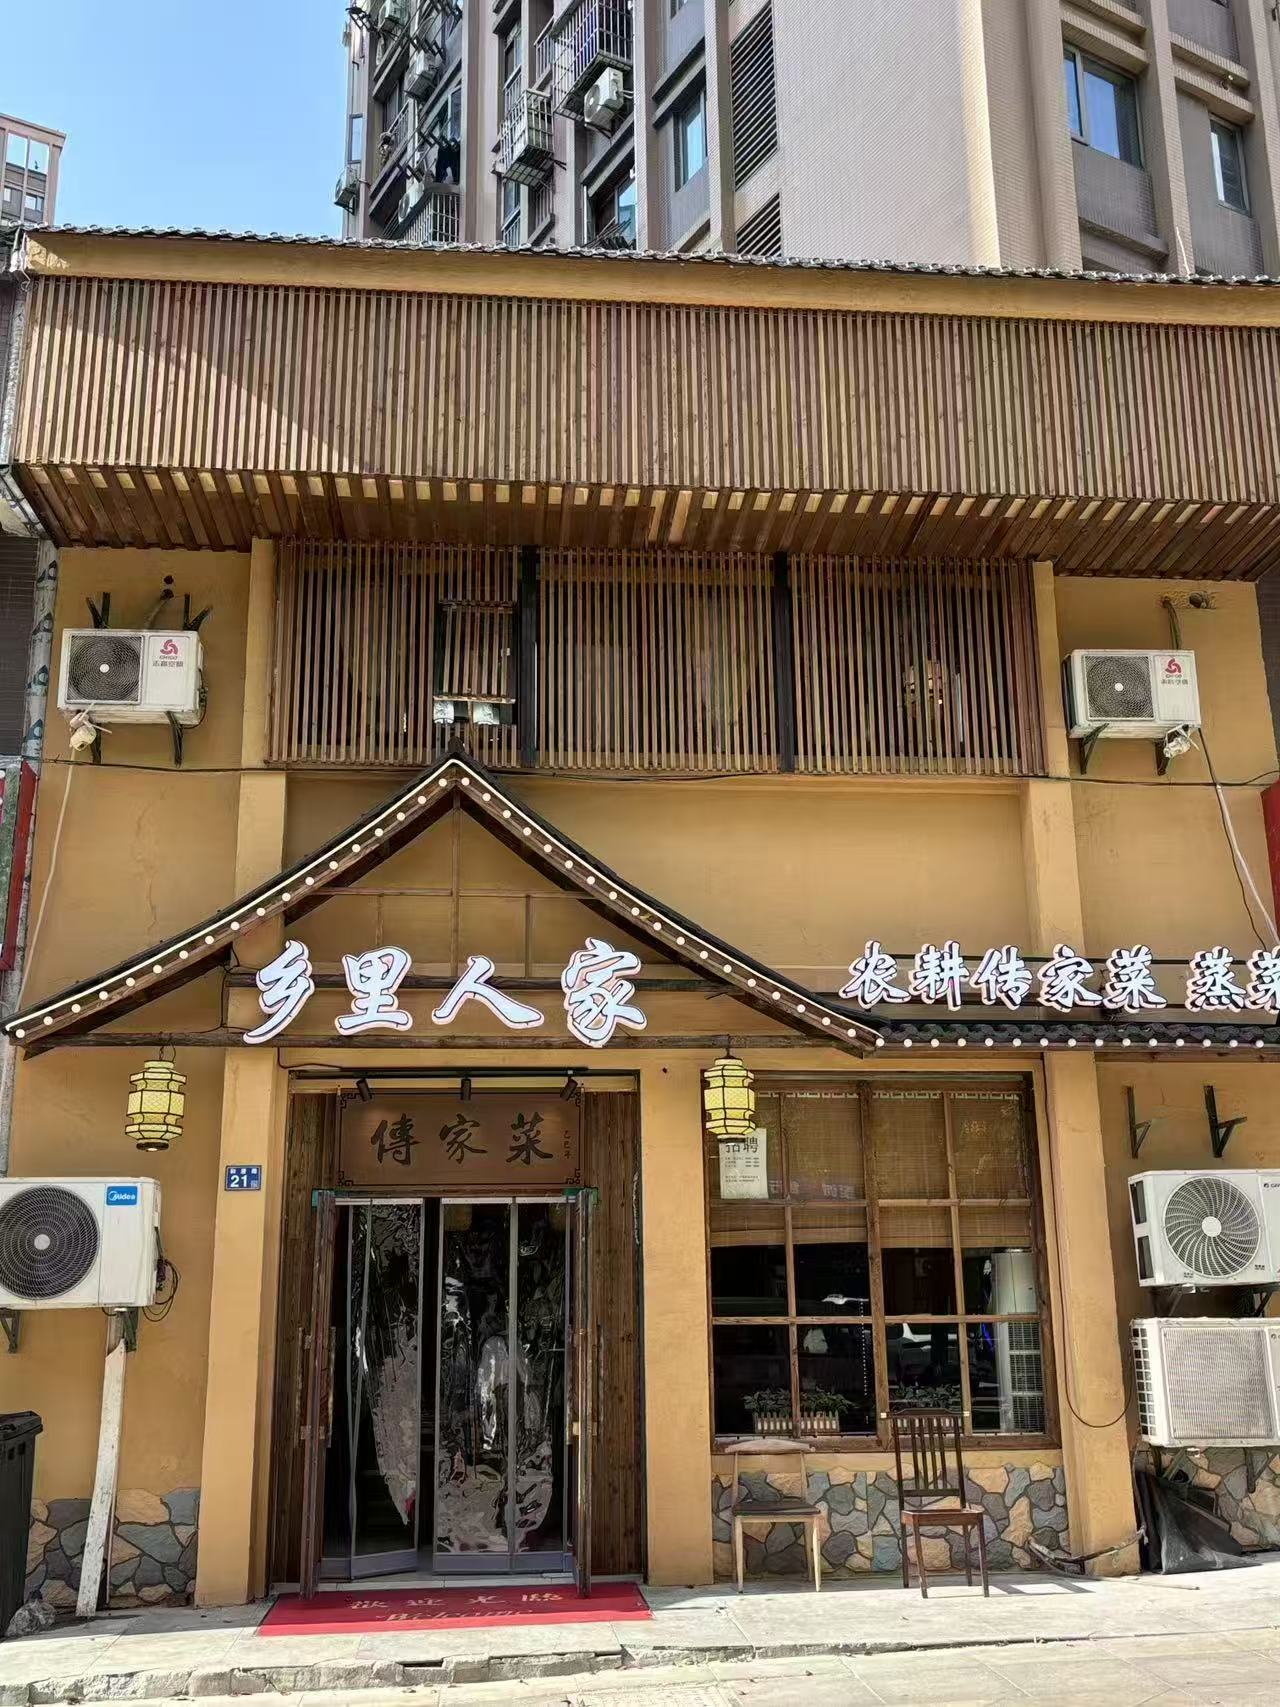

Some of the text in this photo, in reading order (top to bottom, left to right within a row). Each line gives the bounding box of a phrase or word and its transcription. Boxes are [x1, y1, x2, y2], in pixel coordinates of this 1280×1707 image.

[243, 937, 648, 1048] 乡里人家
[839, 940, 1168, 1013] 农耕传家菜
[370, 1111, 554, 1166] 傳家菜
[109, 1190, 136, 1201] Midea
